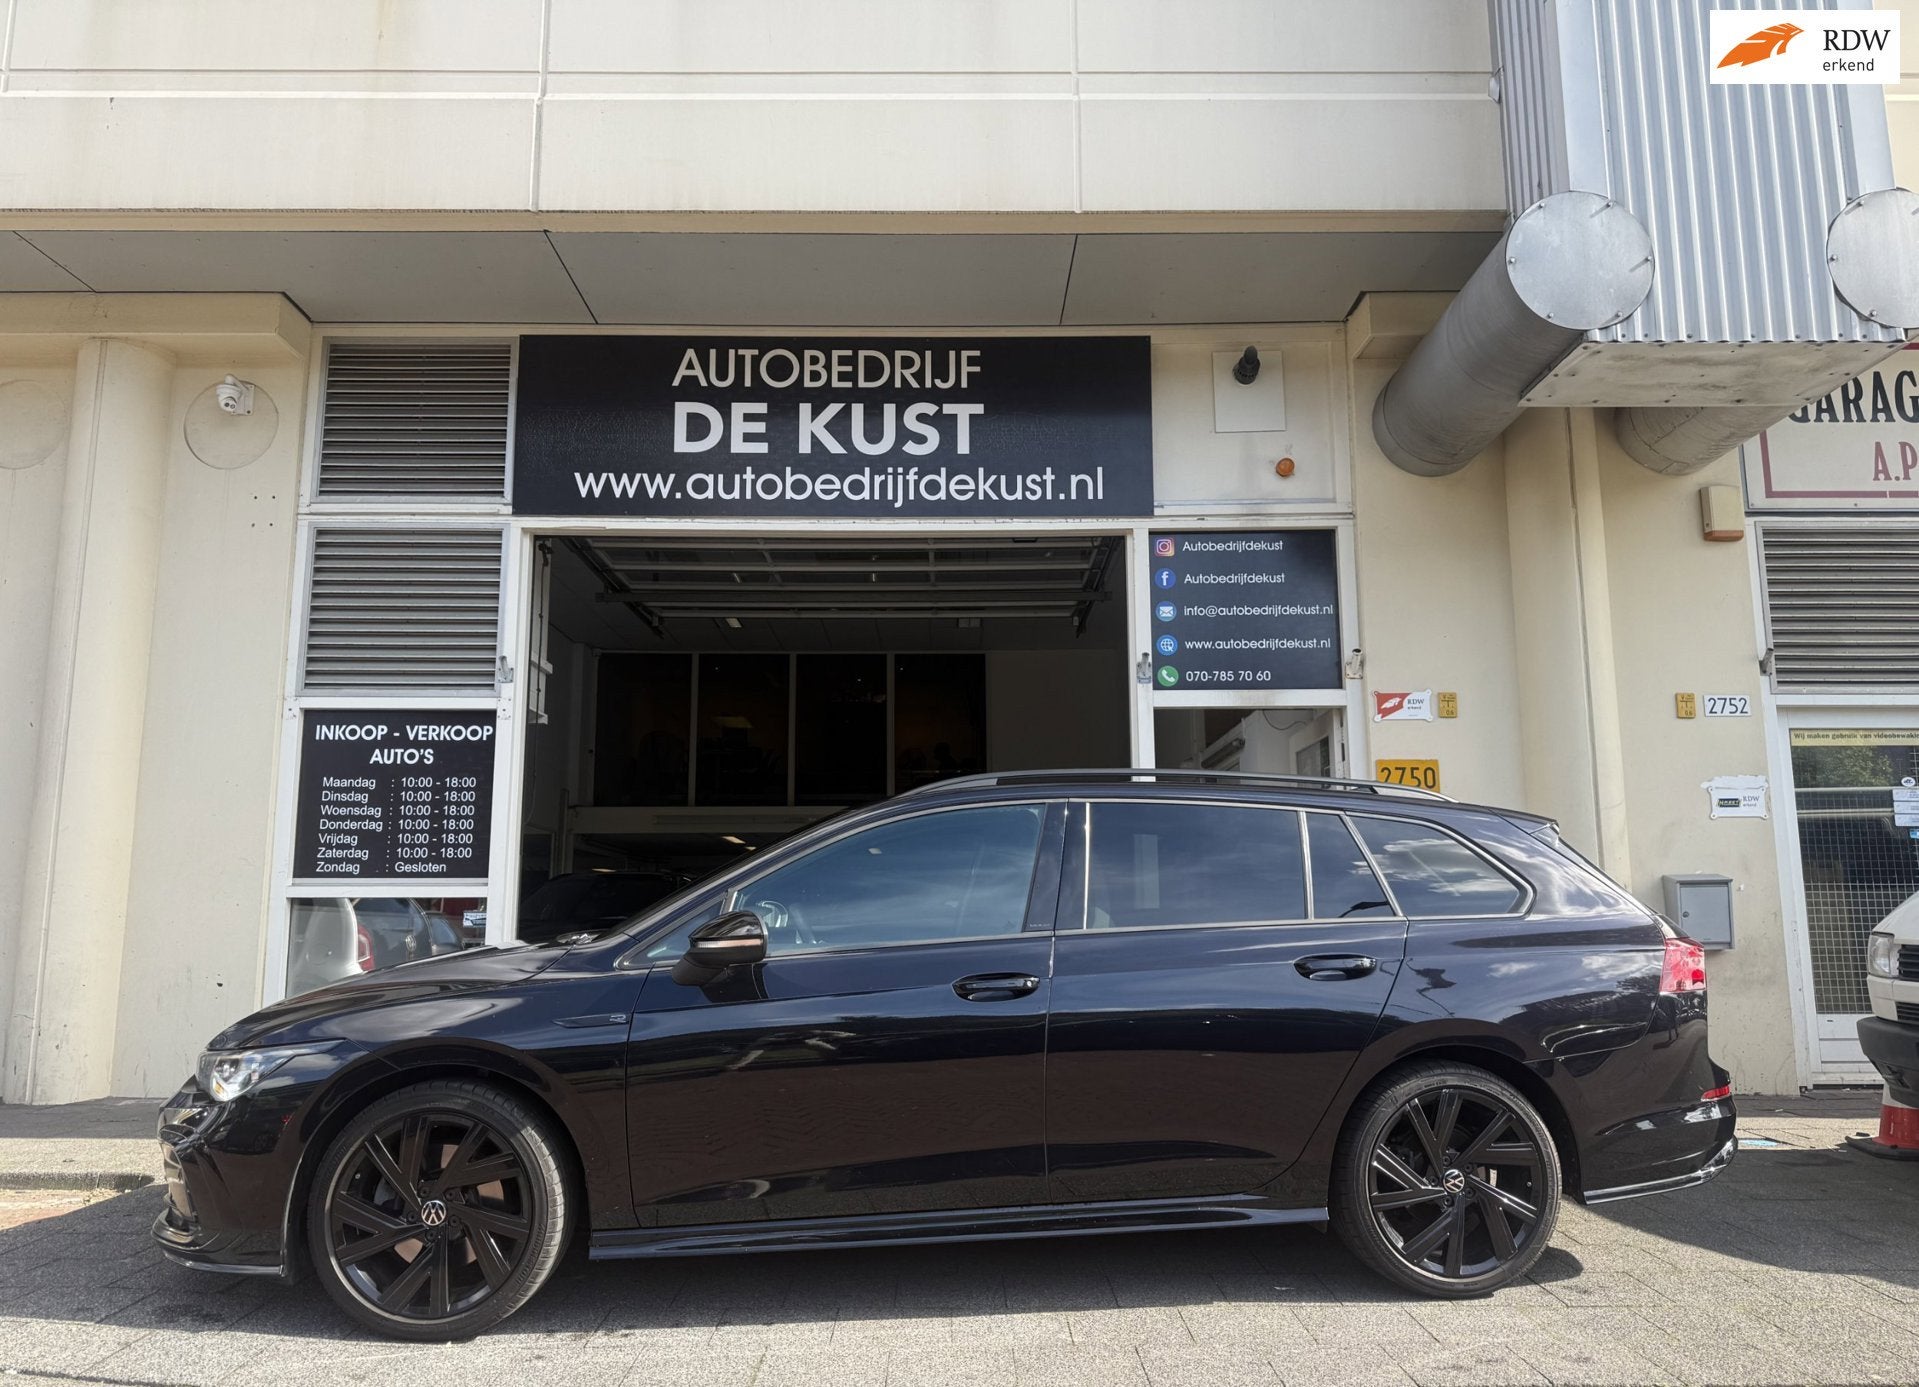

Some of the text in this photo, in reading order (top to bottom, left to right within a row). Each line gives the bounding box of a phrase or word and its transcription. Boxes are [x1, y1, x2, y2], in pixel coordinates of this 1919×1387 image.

[672, 349, 980, 388] AUTOBEDRIJF
[674, 402, 984, 455] DE KUST
[574, 467, 1103, 508] www.autobedrijfdekust.nl
[1183, 541, 1282, 552] Autobedrijfdekust
[1184, 573, 1284, 585] Autobedrijfdekust
[1184, 605, 1333, 617] info@autobedrijfdekust.nl
[1185, 639, 1330, 650] www.autobedrijfdekust.nl
[1186, 671, 1271, 681] 070-785 70 60
[1708, 698, 1748, 714] 2752
[316, 725, 387, 740] INKOOP
[406, 725, 493, 740] VERKOOP
[370, 749, 433, 764] AUTO'S
[323, 777, 375, 789] Maandag
[402, 777, 432, 787] 10:00
[445, 777, 476, 787] 18:00
[322, 791, 368, 803] Dinsdag
[401, 791, 431, 801] 10:00
[445, 791, 475, 801] 18:00
[321, 805, 381, 818] Woensdag
[400, 805, 430, 815] 10:00
[444, 805, 474, 815] 18:00
[320, 819, 382, 832] Donderdag
[399, 819, 430, 829] 10:00
[443, 819, 473, 829] 18:00
[319, 833, 357, 846] Vrijdag
[398, 834, 429, 843] 10:00
[442, 834, 473, 843] 18:00
[317, 847, 368, 860] Zaterdag
[397, 848, 428, 858] 10:00
[441, 848, 472, 858] 18:00
[316, 862, 359, 874] Zondag
[395, 862, 446, 872] Gesloten
